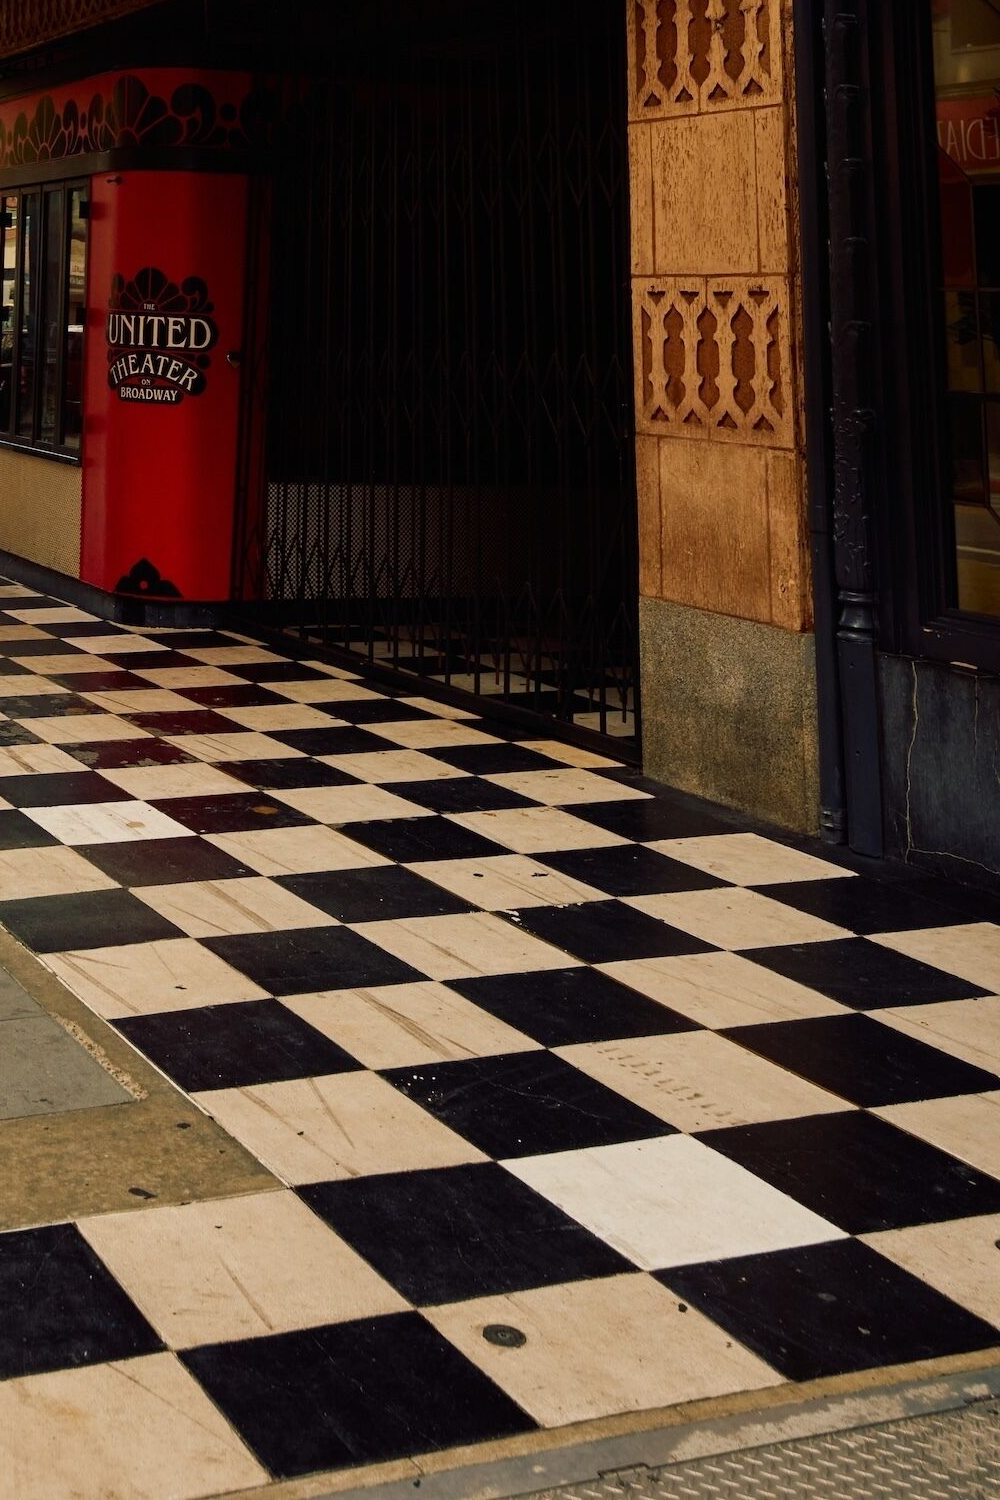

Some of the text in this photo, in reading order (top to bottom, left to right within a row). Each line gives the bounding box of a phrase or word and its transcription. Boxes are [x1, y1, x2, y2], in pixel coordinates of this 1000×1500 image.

[109, 314, 211, 349] UNITED
[110, 353, 198, 391] THEATER
[120, 386, 178, 401] BROADWAY
